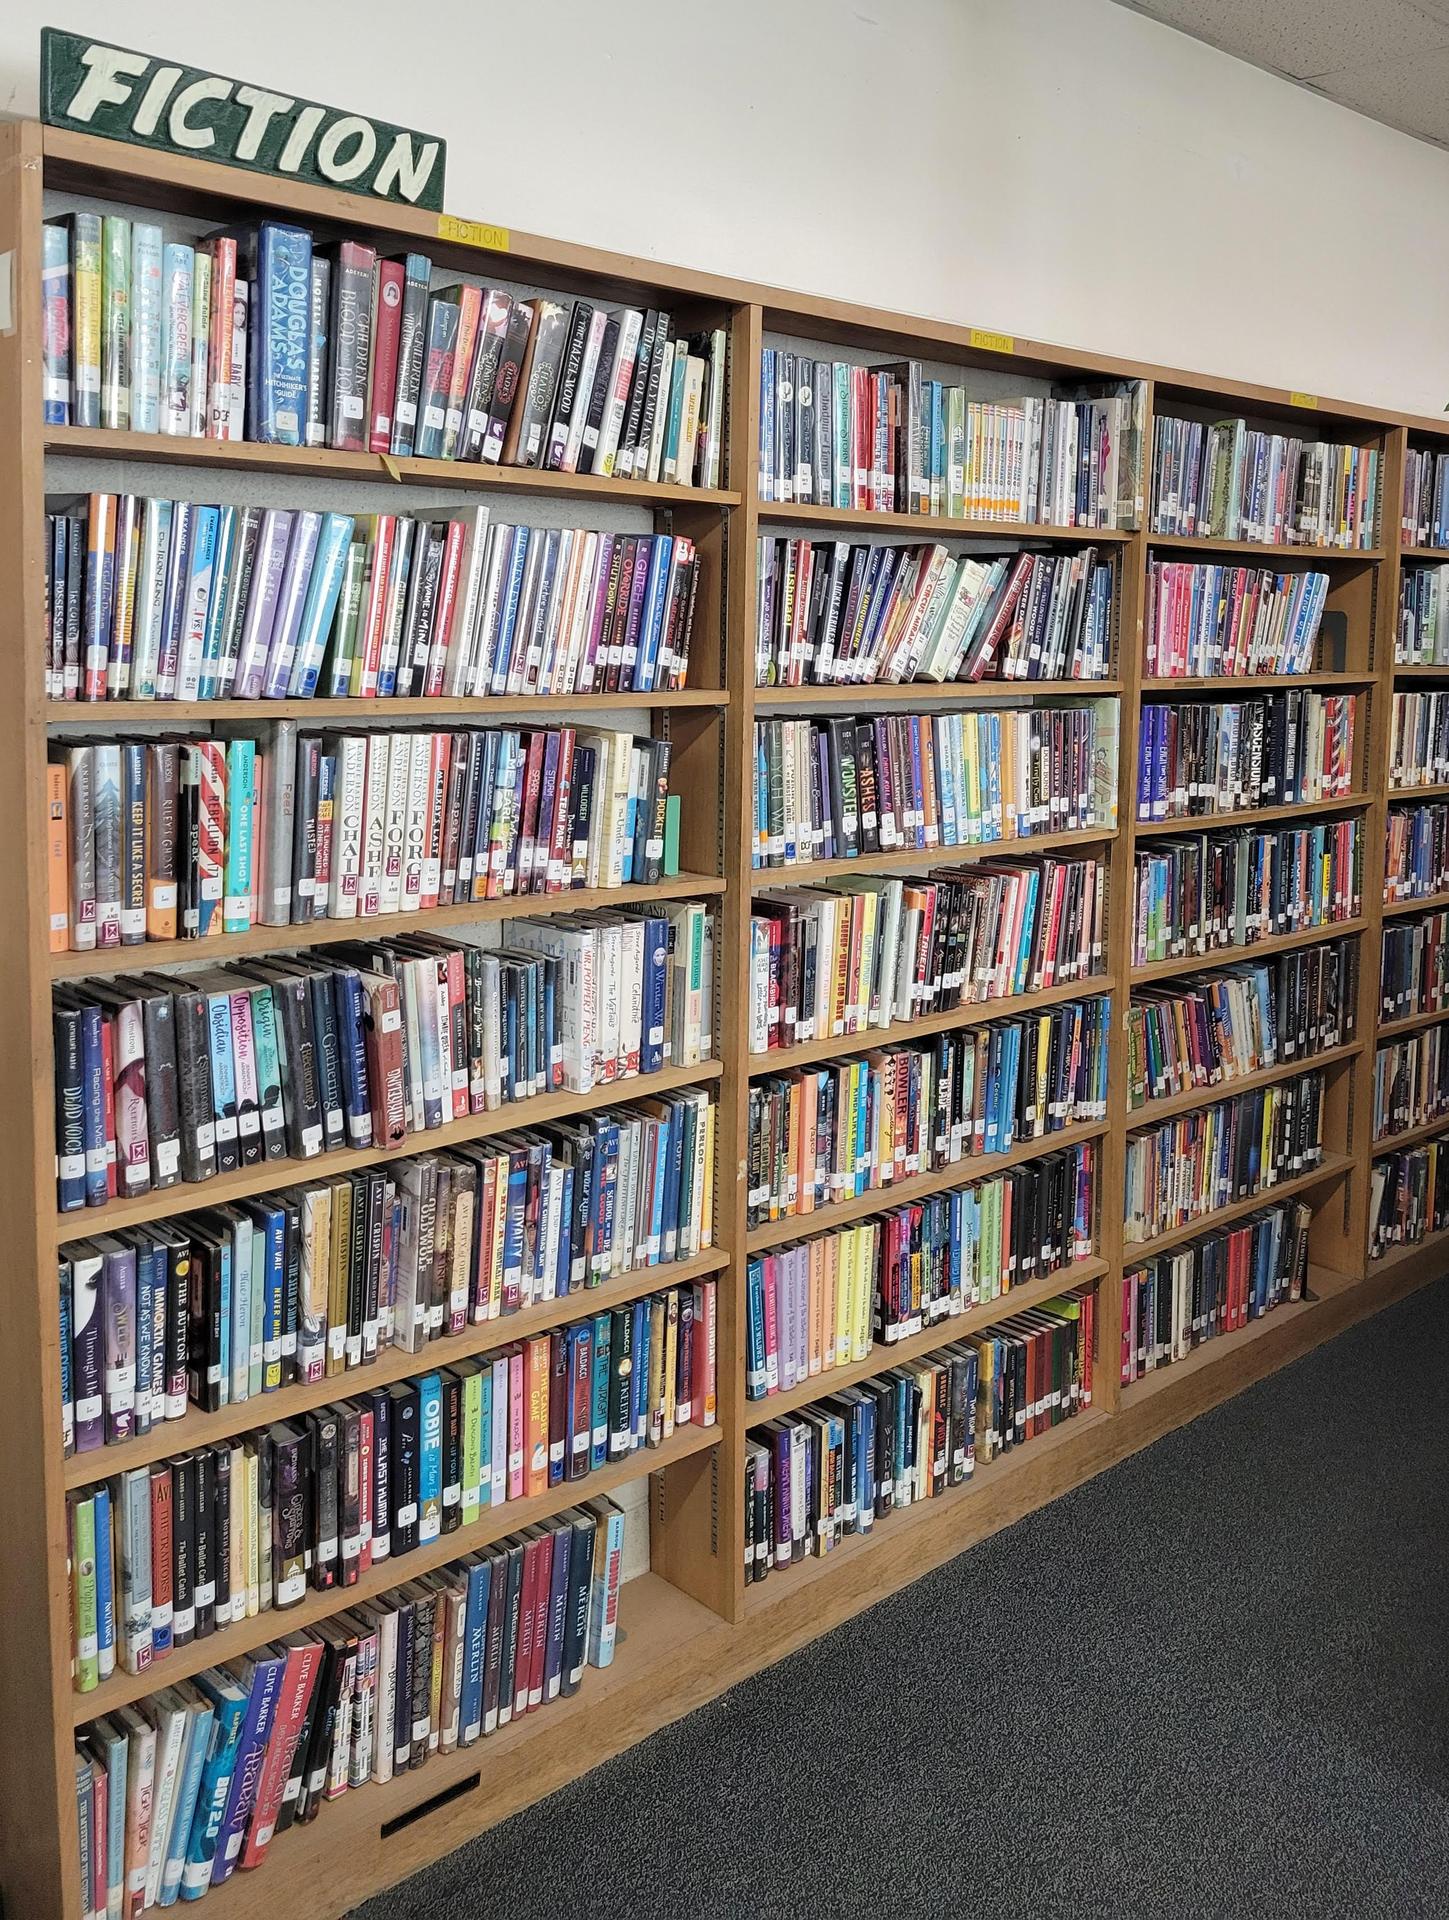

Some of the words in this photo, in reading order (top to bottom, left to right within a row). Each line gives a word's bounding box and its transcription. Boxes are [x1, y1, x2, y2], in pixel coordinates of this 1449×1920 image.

[67, 45, 438, 202] FICTION
[447, 220, 504, 246] FICTION
[271, 274, 288, 354] ADAMS
[312, 274, 322, 326] MOSTLY
[341, 289, 357, 345] BLOOD
[287, 266, 308, 370] DOUGLAS
[576, 320, 587, 338] THE
[657, 317, 669, 348] THE
[356, 312, 369, 387] CHILDREN
[566, 338, 585, 376] HAZEL
[644, 327, 656, 353] THE
[974, 332, 1010, 350] FICTION
[411, 330, 424, 394] CHILDREN
[639, 354, 649, 376] SIX
[652, 348, 664, 370] SIX
[265, 379, 307, 392] HITCHHIKER'S
[275, 389, 297, 399] GUIDE
[312, 357, 320, 420] HARMLESS
[535, 367, 549, 407] HALO
[561, 376, 577, 414] WOOD
[641, 373, 660, 449] OLYMPIANS
[155, 550, 166, 577] IRON
[1035, 561, 1044, 590] ALONE
[154, 580, 165, 607] RING
[238, 564, 253, 608] Absolutely
[422, 582, 433, 609] NAME
[633, 559, 647, 604] GLITCH
[832, 580, 844, 607] LUCKY
[917, 583, 935, 613] CIRCUS
[784, 573, 795, 626] Ishmael
[237, 608, 246, 627] True
[828, 609, 839, 644] STRIKES
[853, 593, 871, 649] VANQUISHERS
[1028, 605, 1039, 637] WOODS
[231, 628, 242, 651] Diary
[164, 753, 173, 783] ANDERSON
[473, 742, 482, 781] ANDERSON
[1250, 722, 1264, 787] ASCENSION
[81, 763, 91, 819] ANDERSON
[345, 743, 354, 812] ANDERSON
[392, 741, 402, 808] ANDERSON
[413, 741, 424, 808] ANDERSON
[530, 769, 540, 797] SPARK
[546, 769, 556, 797] STORM
[860, 769, 876, 812] ASHES
[132, 801, 144, 825] KEEP
[161, 799, 173, 836] RILEY'S
[240, 805, 250, 830] ONE
[281, 783, 293, 817] Feed
[433, 788, 443, 824] BIXBY'S
[502, 788, 512, 824] EARL
[557, 796, 568, 823] TEAM
[579, 783, 590, 822] WILLODEEN
[654, 798, 666, 834] POCKET
[132, 827, 143, 836] IT
[208, 795, 220, 856] REBELLION
[306, 818, 315, 854] TWISTED
[450, 801, 460, 844] speak
[555, 824, 566, 849] PARK
[132, 839, 144, 862] LIKE
[161, 839, 173, 878] GHOST
[191, 823, 200, 863] speak
[239, 831, 248, 858] LAST
[342, 814, 360, 874] CHAI
[407, 810, 424, 875] FORG
[432, 829, 440, 855] LAST
[238, 859, 247, 884] SHOT
[131, 871, 144, 908] SECRET
[583, 950, 591, 967] MR.
[918, 934, 929, 973] TAKEN
[583, 967, 592, 1014] POPPER'S
[654, 969, 665, 1009] Winter
[769, 963, 777, 1007] BLACKBIRD
[211, 1004, 229, 1056] Obsidian
[232, 996, 250, 1060] Opposition
[256, 996, 275, 1039] Origin
[325, 1016, 335, 1033] the
[355, 1041, 365, 1064] THE
[93, 1067, 102, 1106] Racing
[322, 1032, 340, 1110] Gathering
[357, 1068, 367, 1097] TRAP
[896, 1057, 909, 1115] BOWLER
[63, 1086, 83, 1119] DEAD
[938, 1078, 949, 1112] BLADE
[63, 1122, 83, 1155] VOICE
[696, 1121, 706, 1165] PERLOO
[513, 1160, 527, 1169] AVI
[752, 1148, 761, 1175] FALLOUT
[375, 1186, 383, 1206] AVI
[581, 1169, 591, 1194] WOLF
[420, 1203, 430, 1234] OLD
[427, 1197, 436, 1228] OLD
[579, 1196, 589, 1227] RIDER
[605, 1189, 614, 1222] SCHOOL
[274, 1229, 283, 1244] AVI
[355, 1223, 364, 1263] CRISPIN
[372, 1222, 381, 1260] CRISPIN
[425, 1228, 435, 1265] WOLF
[511, 1204, 525, 1258] LOYALTY
[274, 1251, 283, 1271] VAIL
[340, 1231, 348, 1272] CRISPIN
[418, 1235, 428, 1273] WOLF
[141, 1286, 151, 1308] NOT
[177, 1280, 187, 1306] THE
[273, 1287, 281, 1316] NEVER
[140, 1322, 151, 1342] WE
[141, 1309, 151, 1321] AS
[154, 1287, 165, 1350] IMMORTAL
[83, 1327, 98, 1375] Through
[177, 1311, 187, 1360] BUTTON
[623, 1313, 631, 1354] BALDACCI
[140, 1345, 151, 1377] KNOW
[152, 1352, 164, 1395] GAMES
[578, 1346, 588, 1380] BALDACCI
[540, 1371, 549, 1394] THE
[938, 1375, 947, 1408] BRUCHAC
[530, 1390, 540, 1422] GAME
[538, 1395, 549, 1436] CALDER
[619, 1387, 630, 1433] KEEPER
[423, 1400, 440, 1450] OBIE
[936, 1424, 946, 1448] WOLF
[378, 1455, 388, 1485] LAST
[428, 1464, 437, 1486] Man
[161, 1507, 169, 1532] THE
[377, 1487, 388, 1528] HUMAN
[178, 1554, 187, 1577] Bullet
[198, 1545, 206, 1567] Bullet
[80, 1584, 95, 1612] Poppy
[178, 1578, 187, 1600] Catch
[536, 1601, 547, 1648] MERLIN
[552, 1594, 564, 1642] MERLIN
[575, 1585, 587, 1637] MERLIN
[489, 1625, 500, 1670] MERLIN
[521, 1609, 533, 1656] MERLIN
[298, 1652, 312, 1681] CLIVE
[469, 1627, 483, 1684] MERLIN
[263, 1666, 278, 1694] CLIVE
[255, 1696, 271, 1735] BARKER
[290, 1683, 306, 1720] BARKER
[213, 1775, 231, 1810] BOY
[205, 1810, 223, 1839] 2.0
